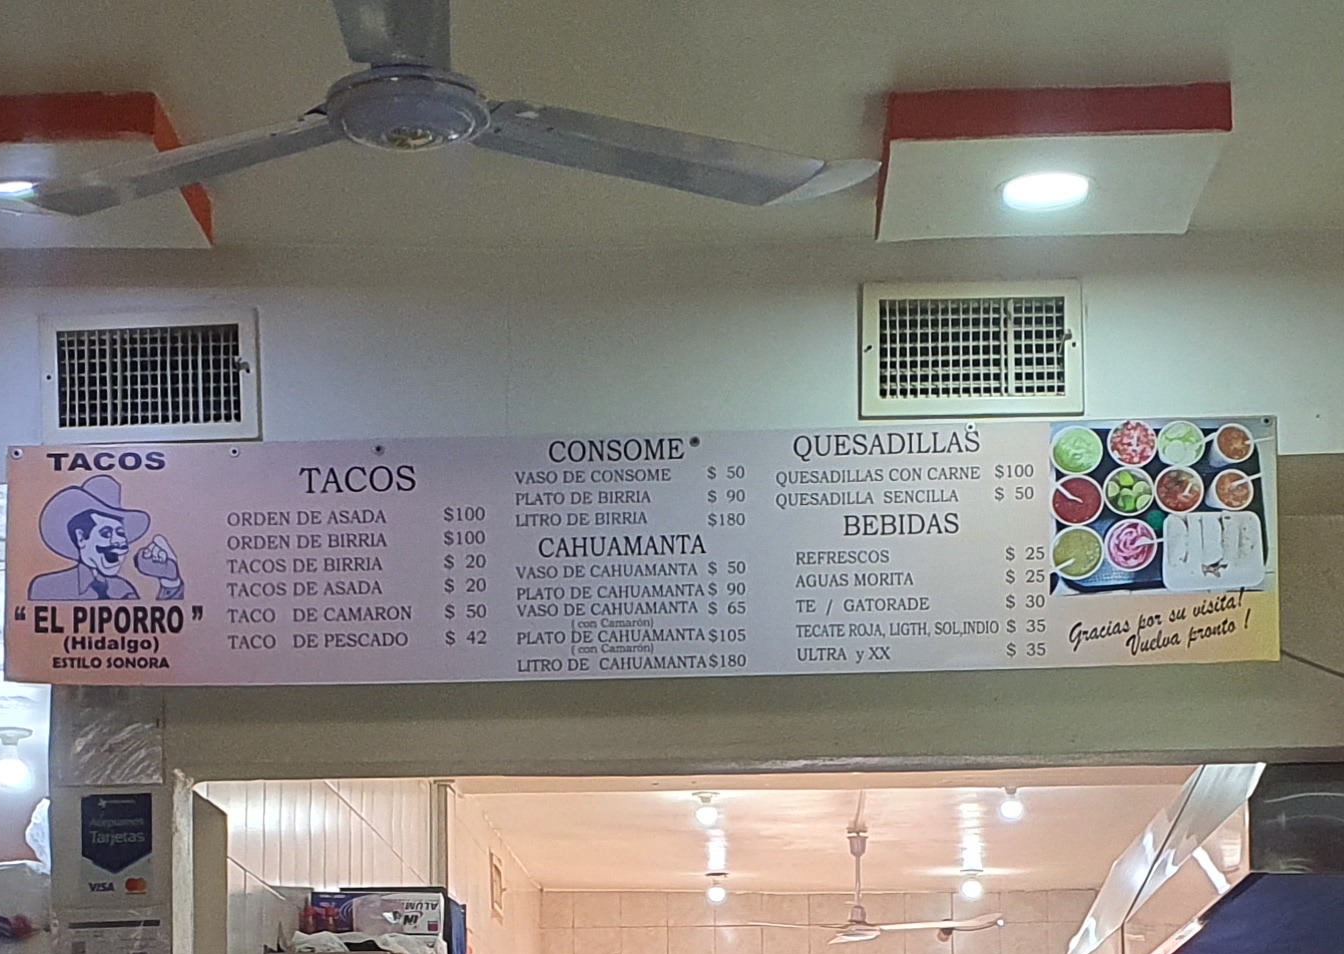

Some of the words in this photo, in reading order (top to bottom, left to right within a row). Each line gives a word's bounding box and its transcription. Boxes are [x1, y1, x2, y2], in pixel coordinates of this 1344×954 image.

[548, 437, 685, 463] CONSOME
[793, 431, 981, 461] QUESADILLAS
[47, 452, 166, 471] TACOS
[298, 465, 417, 494] TACOS
[514, 470, 557, 485] VASO
[562, 470, 586, 484] DE
[590, 468, 672, 483] CONSOME
[726, 466, 745, 479] 50
[775, 469, 884, 487] QUESADILLAS
[888, 467, 922, 482] CON
[926, 466, 981, 481] CARNE
[994, 464, 1034, 480] $100
[515, 492, 565, 506] PLATO
[570, 491, 593, 505] DE
[598, 490, 652, 504] BIRRIA
[726, 489, 746, 502] 90
[775, 492, 874, 510] QUESADILLA
[883, 489, 959, 504] SENCILLA
[1015, 487, 1034, 500] 50
[227, 511, 290, 526] ORDEN
[297, 510, 322, 525] DE
[327, 509, 387, 525] ASADA
[443, 506, 486, 522] $100
[515, 513, 562, 528] LITRO
[566, 512, 590, 526] DE
[594, 511, 648, 525] BIRRIA
[707, 512, 746, 527] $180
[843, 512, 960, 536] BEBIDAS
[227, 535, 290, 550] ORDEN
[297, 534, 322, 549] DE
[327, 532, 387, 548] BIRRIA
[443, 530, 486, 546] $100
[538, 534, 707, 559] CAHUAMANTA
[227, 558, 287, 574] TACOS
[293, 558, 318, 573] DE
[323, 556, 383, 572] BIRRIA
[465, 554, 487, 569] 20
[796, 549, 889, 565] REFRESCOS
[1025, 547, 1045, 560] 25
[515, 566, 557, 580] VASO
[563, 565, 586, 578] DE
[589, 563, 698, 578] CAHUAMANTA
[727, 561, 746, 574] 50
[795, 574, 849, 588] AGUAS
[853, 572, 914, 587] MORITA
[1025, 569, 1045, 583] 25
[226, 582, 287, 598] TACOS
[293, 582, 318, 596] DE
[323, 580, 383, 596] ASADA
[465, 577, 487, 593] 20
[516, 587, 565, 601] PLATO
[570, 586, 593, 600] DE
[597, 584, 705, 599] CAHUAMANTA
[726, 582, 746, 596] 90
[517, 604, 558, 617] VASO
[563, 603, 586, 616] DE
[590, 601, 699, 616] CAHUAMANTA
[727, 601, 746, 615] 65
[796, 599, 816, 613] TE
[843, 597, 930, 612] GATORADE
[1025, 594, 1046, 608] 30
[73, 605, 184, 634] PIPORRO
[227, 608, 276, 624] TACO
[293, 607, 318, 622] DE
[323, 605, 412, 622] CAMARON
[466, 604, 487, 619] 50
[1069, 619, 1130, 652] Gracias
[1137, 613, 1162, 636] por
[1169, 606, 1186, 622] su
[1193, 587, 1245, 618] visita!
[517, 631, 566, 645] PLATO
[571, 630, 593, 644] DE
[597, 628, 705, 643] CAHUAMANTA
[708, 628, 746, 643] $105
[796, 624, 845, 638] TECATE
[848, 623, 886, 638] ROJA,
[1026, 619, 1046, 633] 35
[1126, 632, 1182, 656] Vuelva
[1188, 618, 1237, 649] pronto
[63, 635, 160, 654] (Hidalgo)
[227, 634, 276, 650] TACO
[293, 633, 319, 649] DE
[324, 631, 409, 648] PESCADO
[466, 630, 487, 645] 42
[52, 657, 102, 669] ESTILO
[107, 657, 170, 669] SONORA
[517, 658, 562, 672] LITRO
[567, 658, 589, 671] DE
[599, 655, 706, 670] CAHUAMANTA
[708, 654, 746, 669] $180
[797, 647, 847, 662] ULTRA
[855, 650, 864, 664] y
[868, 646, 891, 660] XX
[1026, 643, 1046, 657] 35
[89, 831, 146, 847] Tarjetas
[88, 882, 115, 892] VISA
